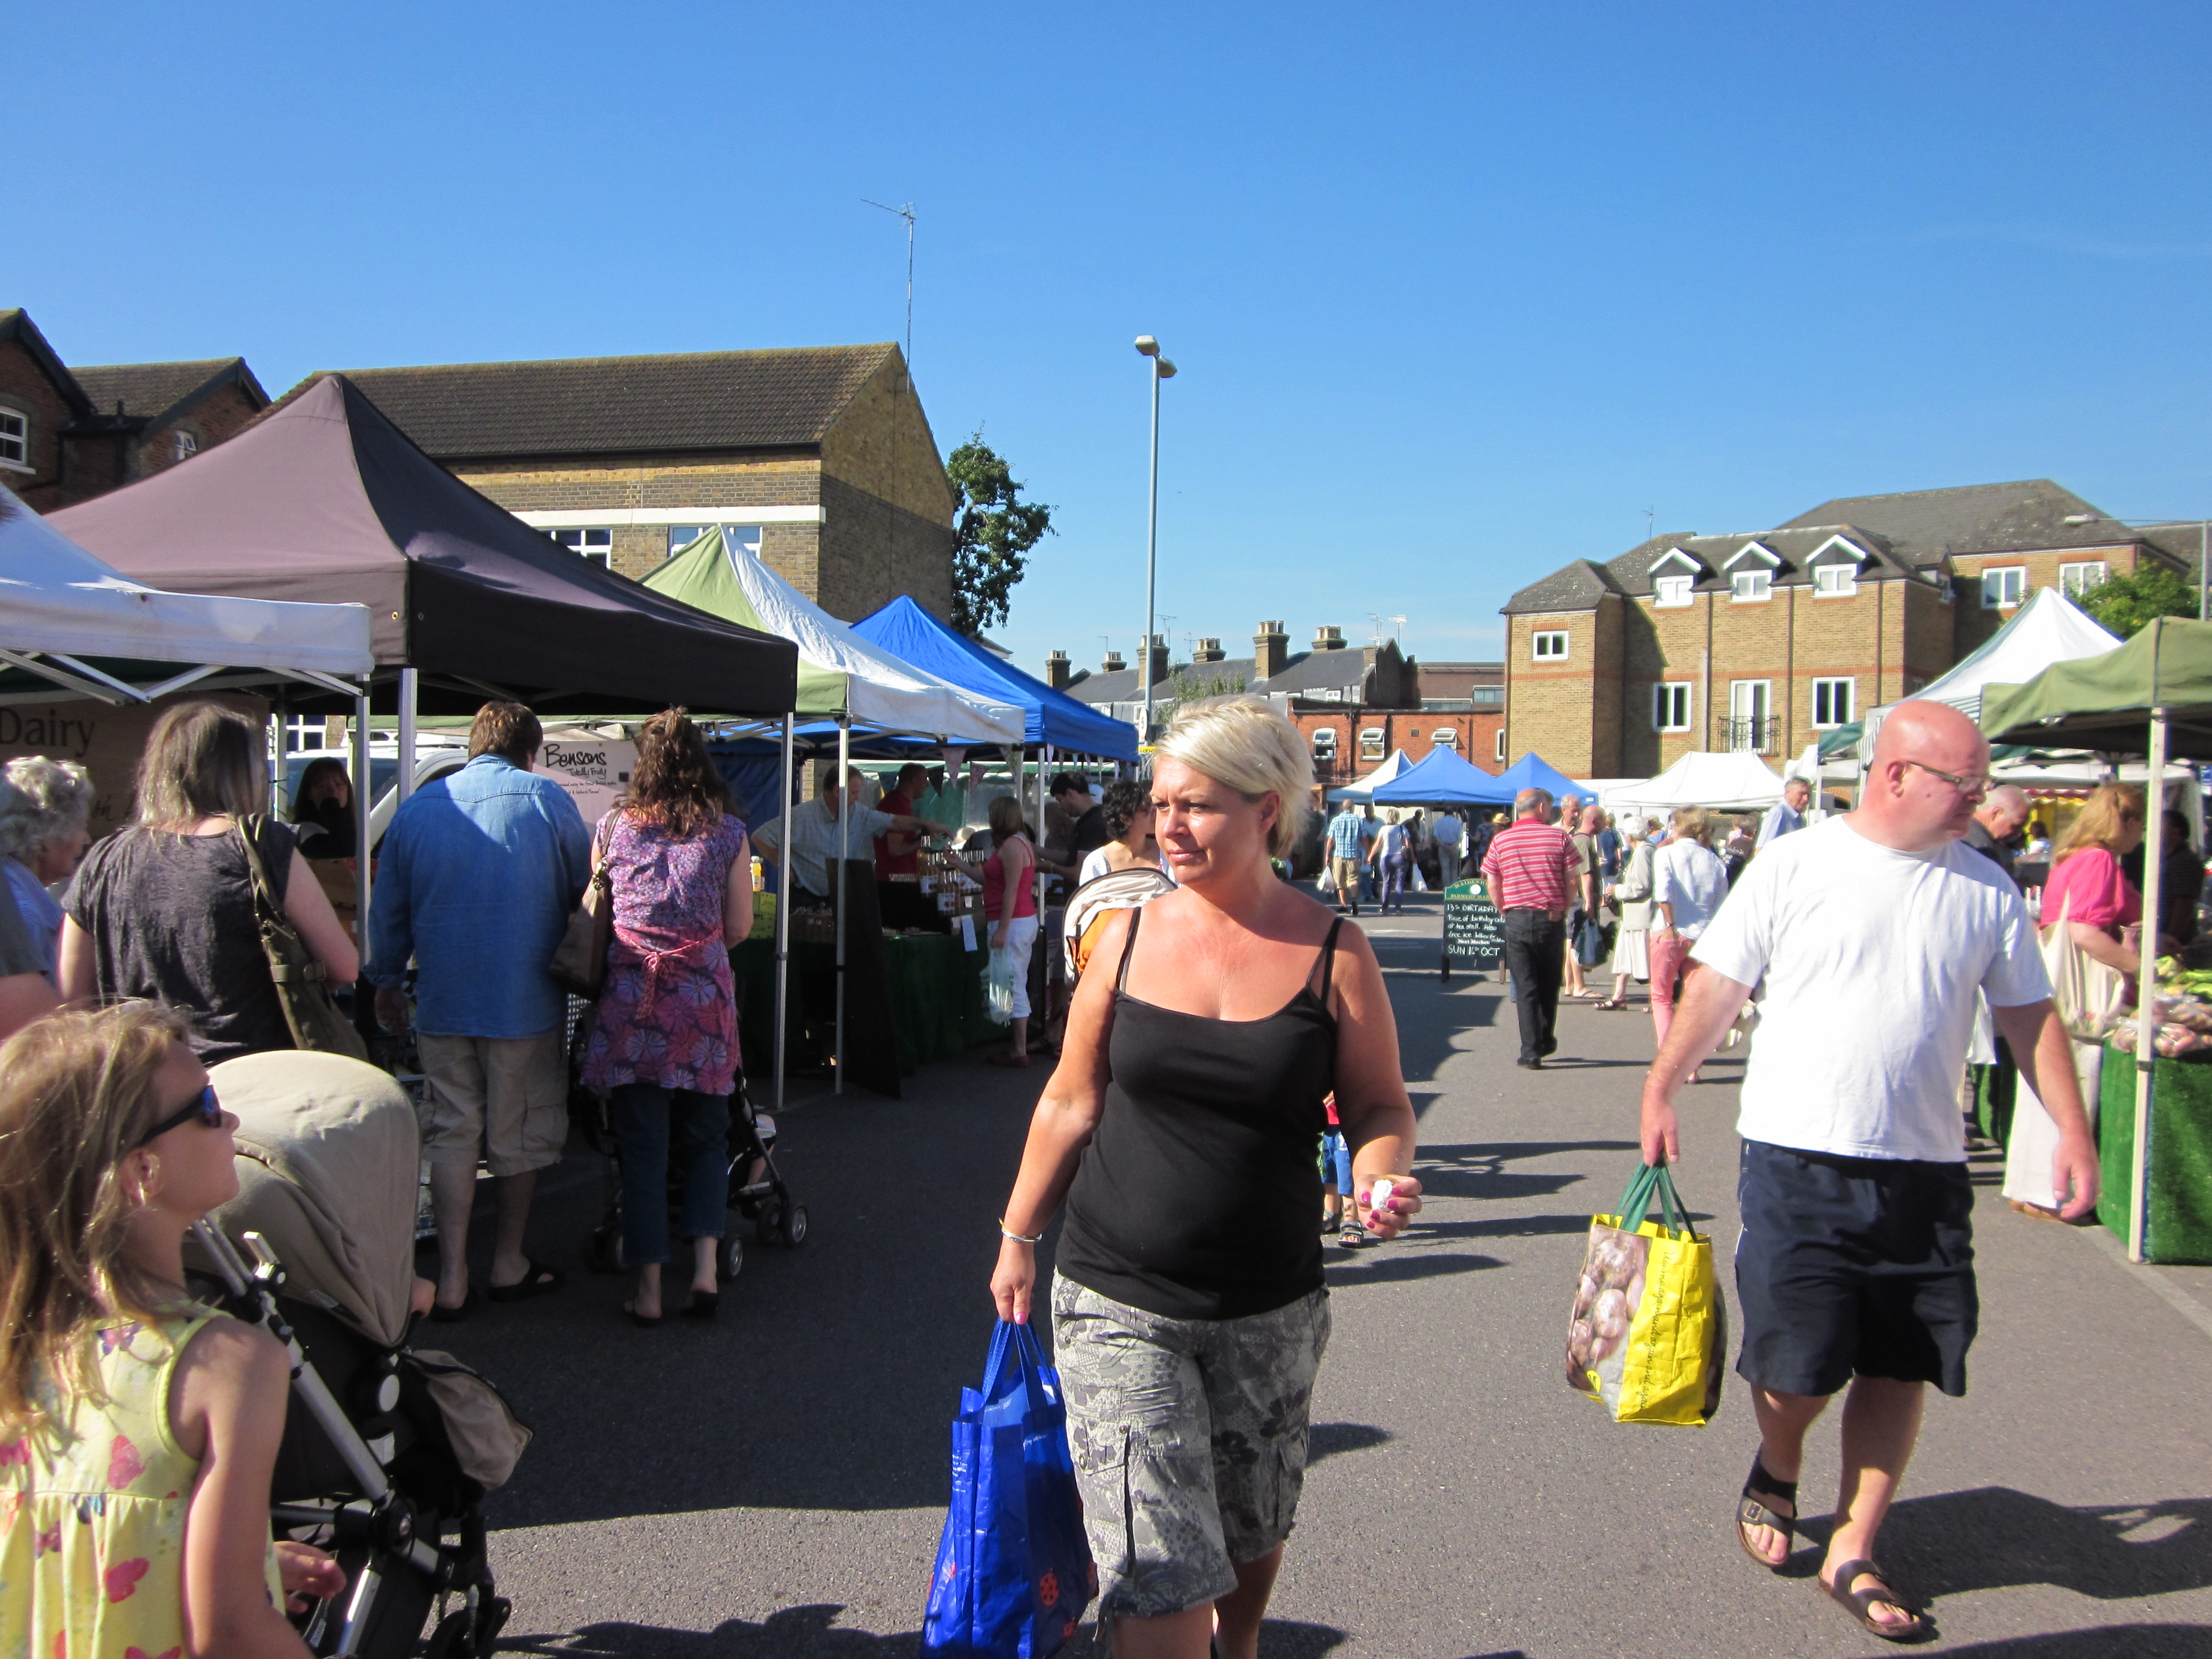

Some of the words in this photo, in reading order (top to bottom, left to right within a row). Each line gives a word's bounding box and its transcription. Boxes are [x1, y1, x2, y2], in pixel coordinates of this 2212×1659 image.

[1141, 717, 1144, 729] 5
[543, 744, 607, 768] Bensons
[566, 767, 589, 778] Totally
[1462, 904, 1498, 913] BIRTHDAY
[1463, 914, 1470, 922] of
[1472, 914, 1493, 925] birthday
[1448, 944, 1465, 956] SUN
[1480, 946, 1500, 957] OCT
[1662, 1251, 1673, 1270] Use
[1660, 1270, 1665, 1287] me
[1653, 1287, 1665, 1316] again
[1651, 1316, 1662, 1336] and
[1643, 1337, 1656, 1364] again
[1644, 1365, 1656, 1385] and
